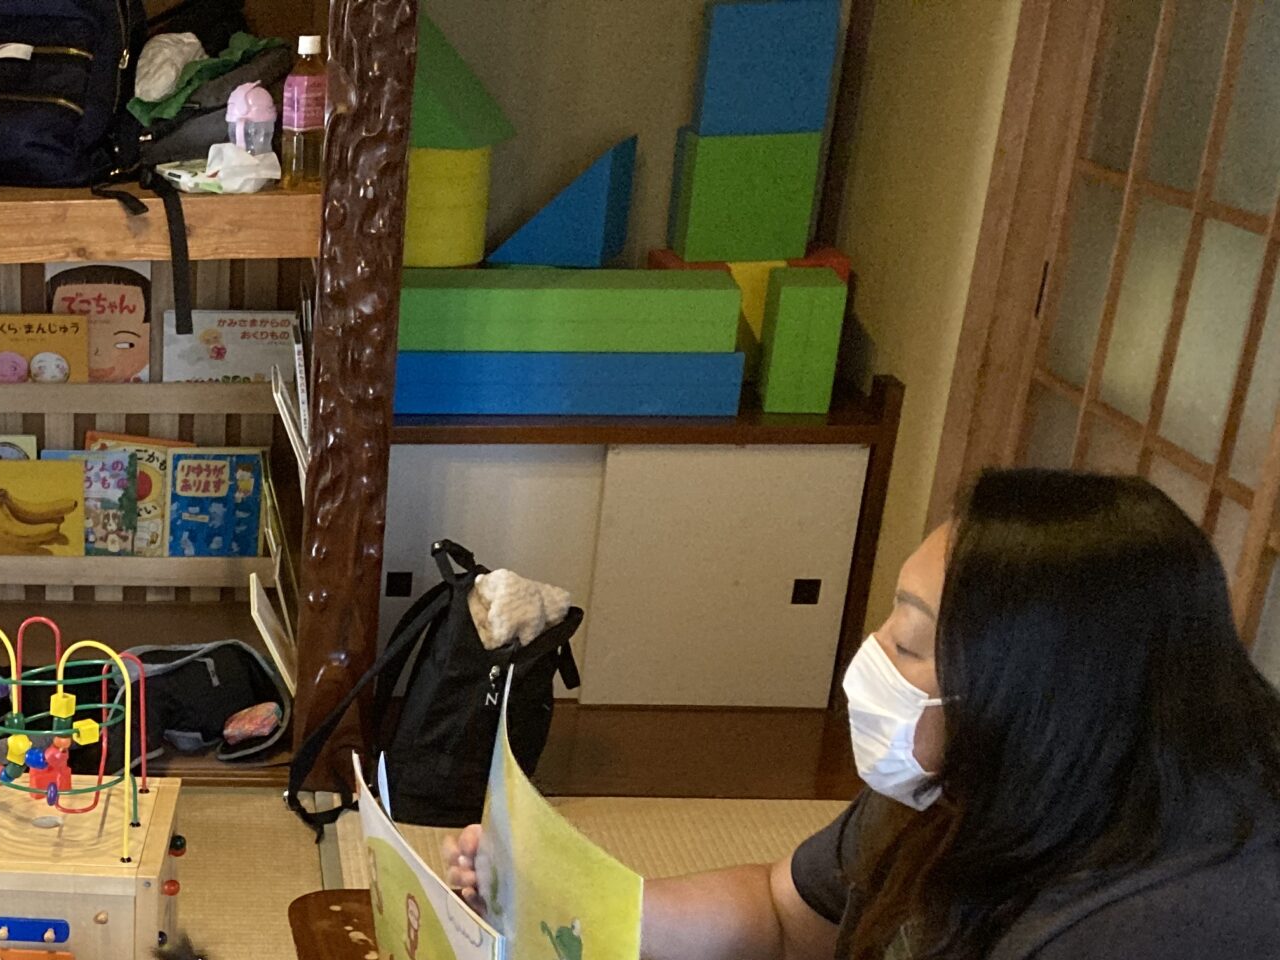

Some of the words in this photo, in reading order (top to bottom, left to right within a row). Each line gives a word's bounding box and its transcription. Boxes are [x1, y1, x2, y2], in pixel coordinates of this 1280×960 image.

[61, 292, 136, 315] でこちゃん
[217, 318, 291, 328] かみさまからの
[240, 330, 290, 340] おくりもの
[180, 478, 226, 493] あります
